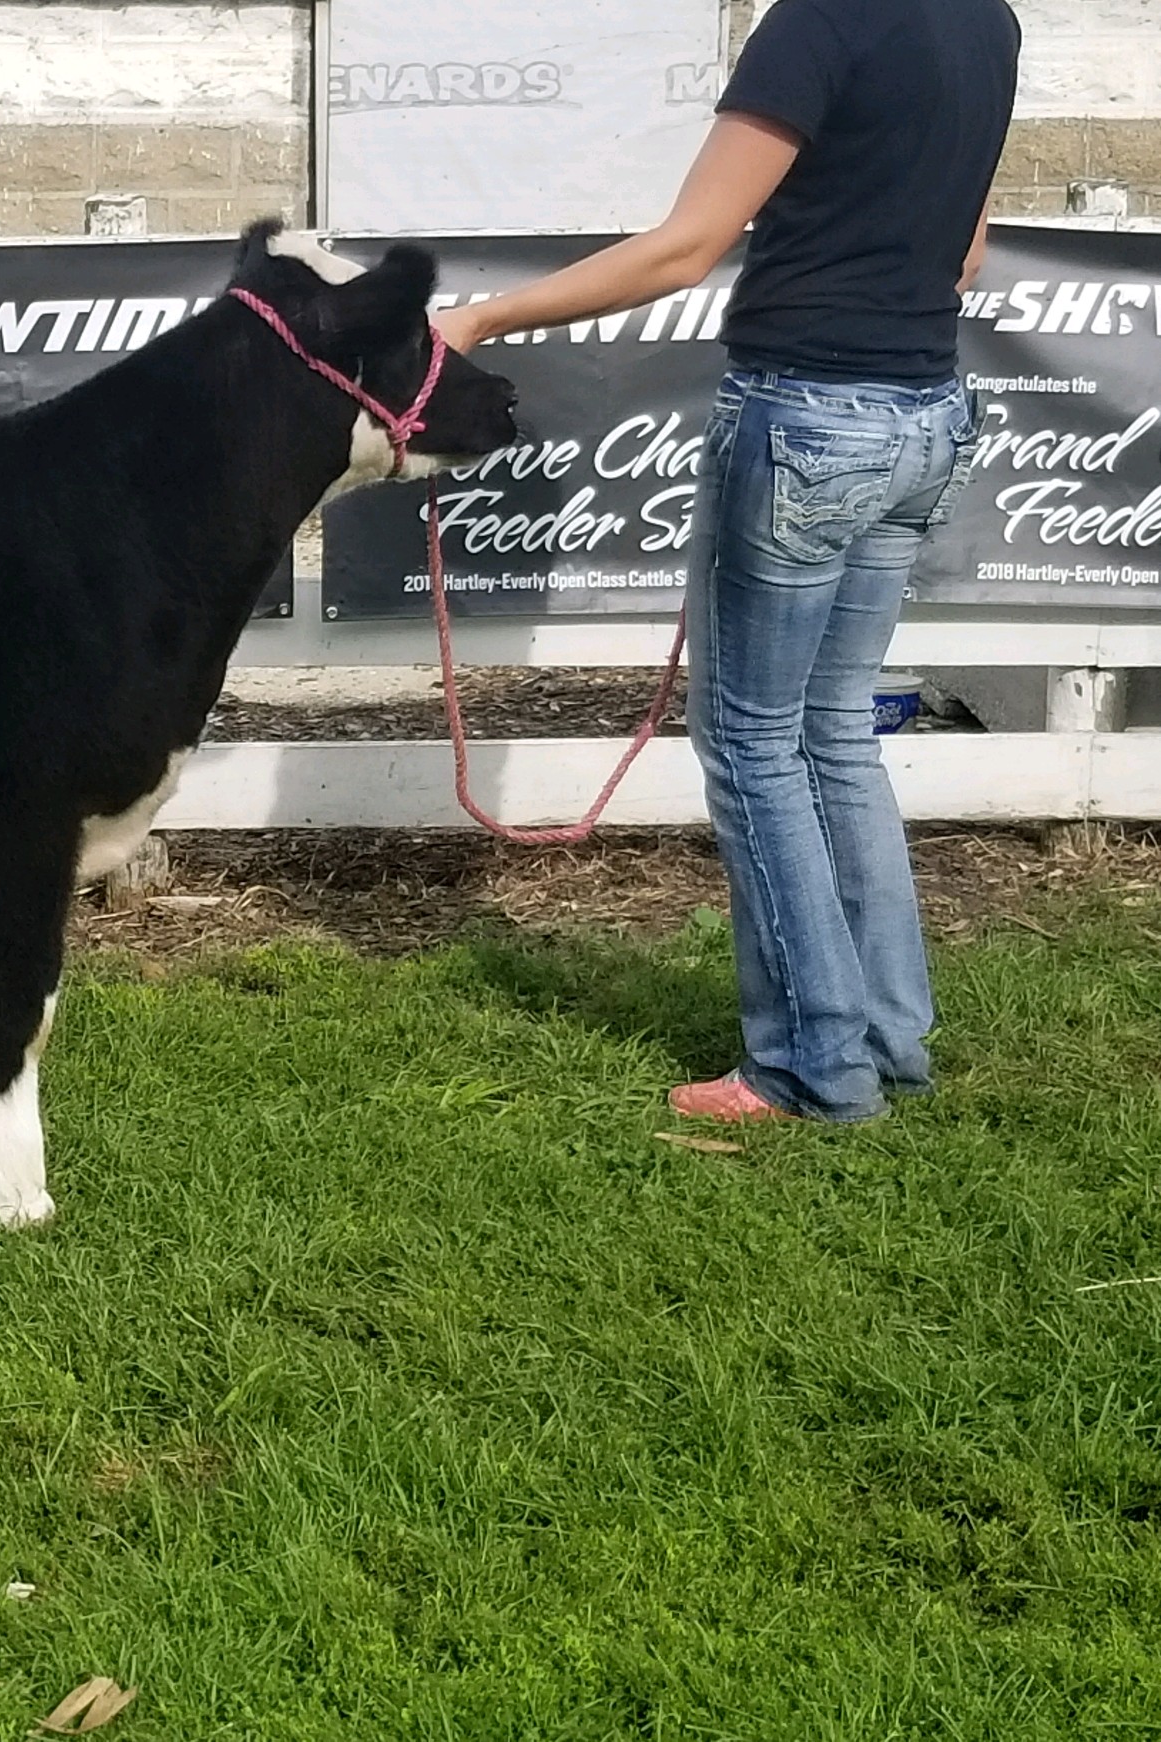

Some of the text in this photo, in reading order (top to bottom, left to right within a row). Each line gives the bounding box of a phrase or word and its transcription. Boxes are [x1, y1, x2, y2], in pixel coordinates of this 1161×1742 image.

[958, 280, 1161, 337] HE SHO
[966, 373, 1097, 394] Congratulates the
[419, 485, 626, 554] Feeder
[404, 575, 443, 592] 201
[444, 572, 546, 593] Hartley-Everly
[548, 571, 586, 592] Open
[587, 570, 627, 588] Class
[628, 569, 673, 587] Cattle
[977, 563, 1159, 586] 2018 Hartley-Everly Open
